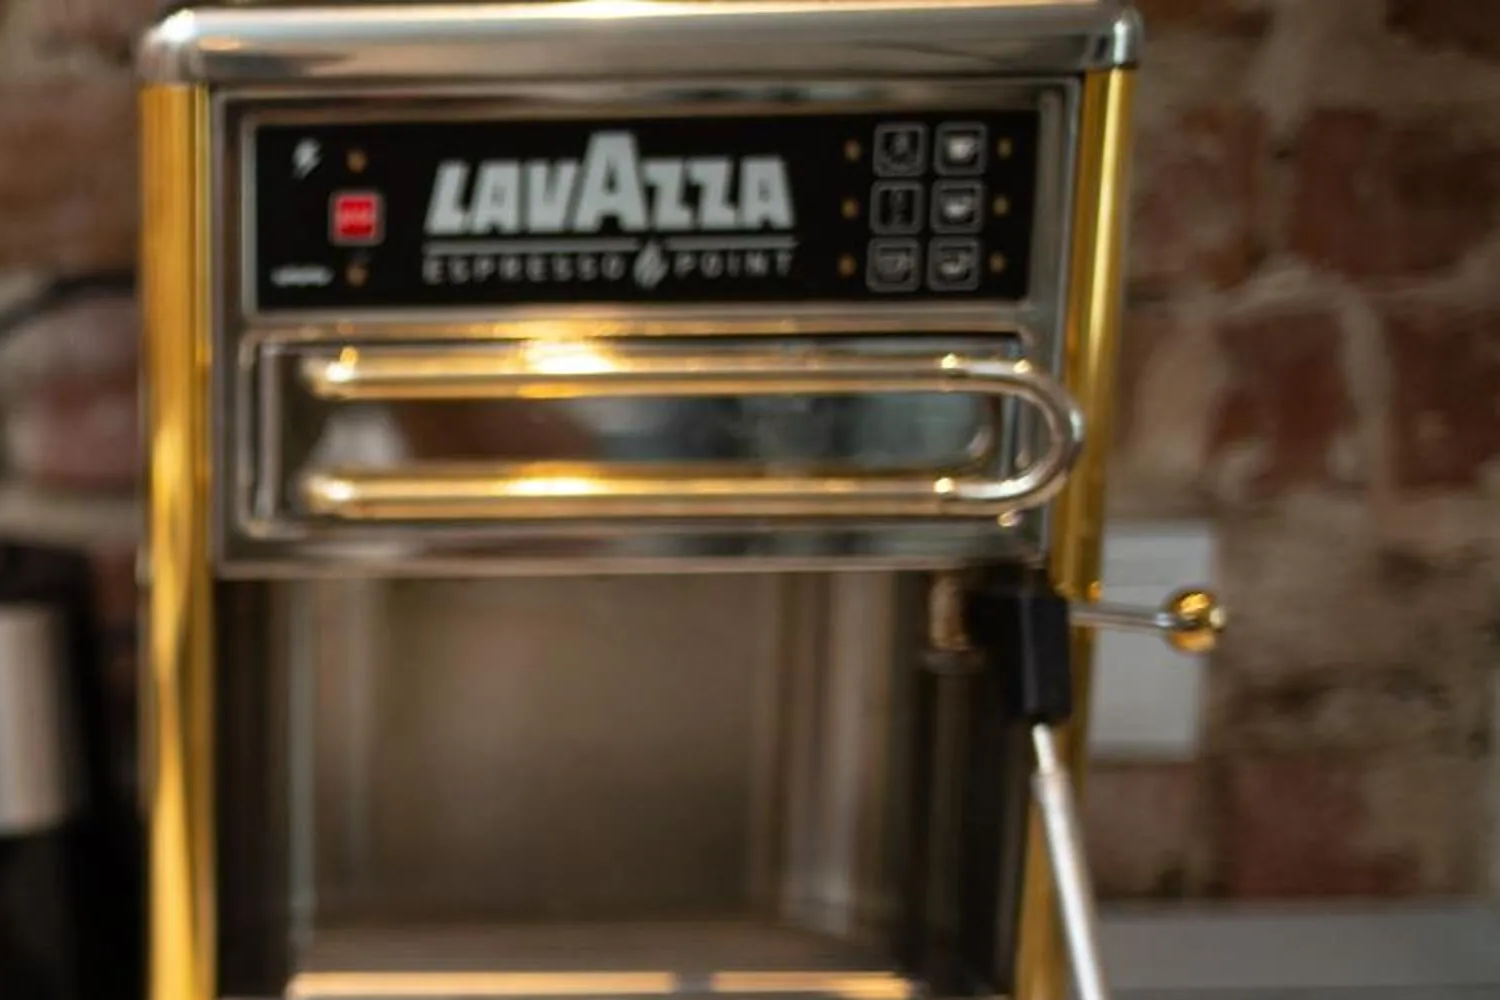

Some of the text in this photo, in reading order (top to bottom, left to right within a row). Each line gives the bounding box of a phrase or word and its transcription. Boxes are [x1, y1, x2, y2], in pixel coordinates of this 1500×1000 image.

[424, 131, 795, 234] LAVAZZA
[421, 249, 794, 285] ESPRESSO POINT
